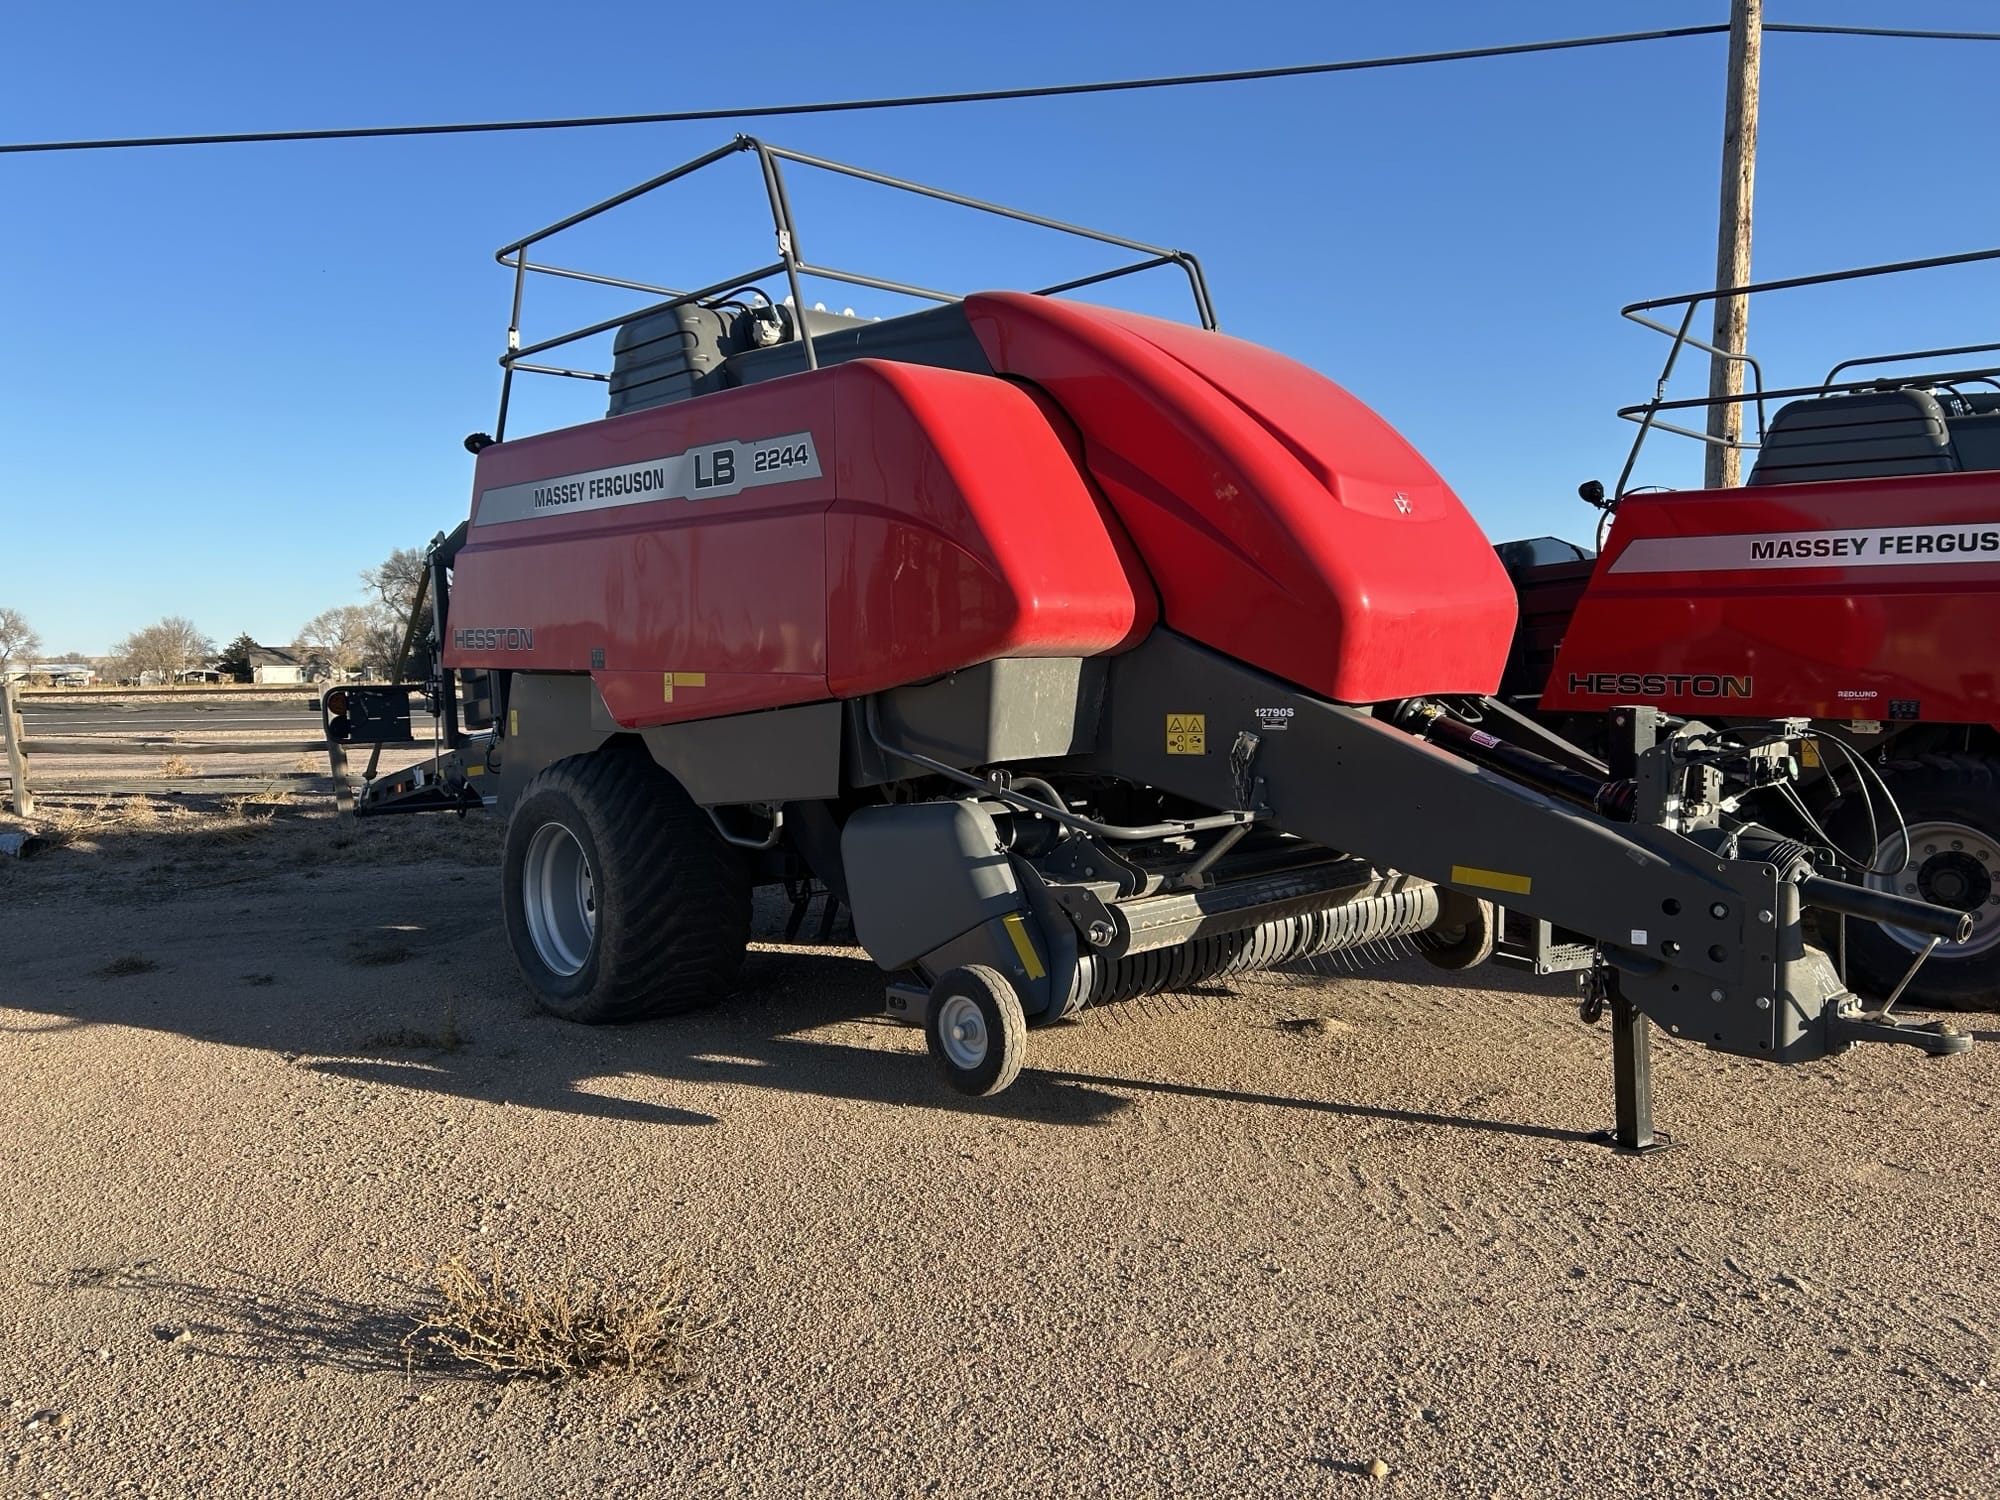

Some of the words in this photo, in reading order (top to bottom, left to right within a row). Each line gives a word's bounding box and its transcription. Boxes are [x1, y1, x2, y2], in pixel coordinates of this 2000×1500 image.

[534, 481, 585, 509] MASSEY
[589, 468, 665, 500] FERGUSON
[694, 448, 736, 490] LB
[754, 443, 809, 474] 2244
[1750, 537, 1869, 561] MASSEY
[1879, 531, 2000, 555] FERGUS
[452, 627, 534, 650] HESSTON
[1567, 672, 1753, 699] HESSTON
[1837, 690, 1878, 698] REDLUND
[1254, 707, 1295, 718] 12790S
